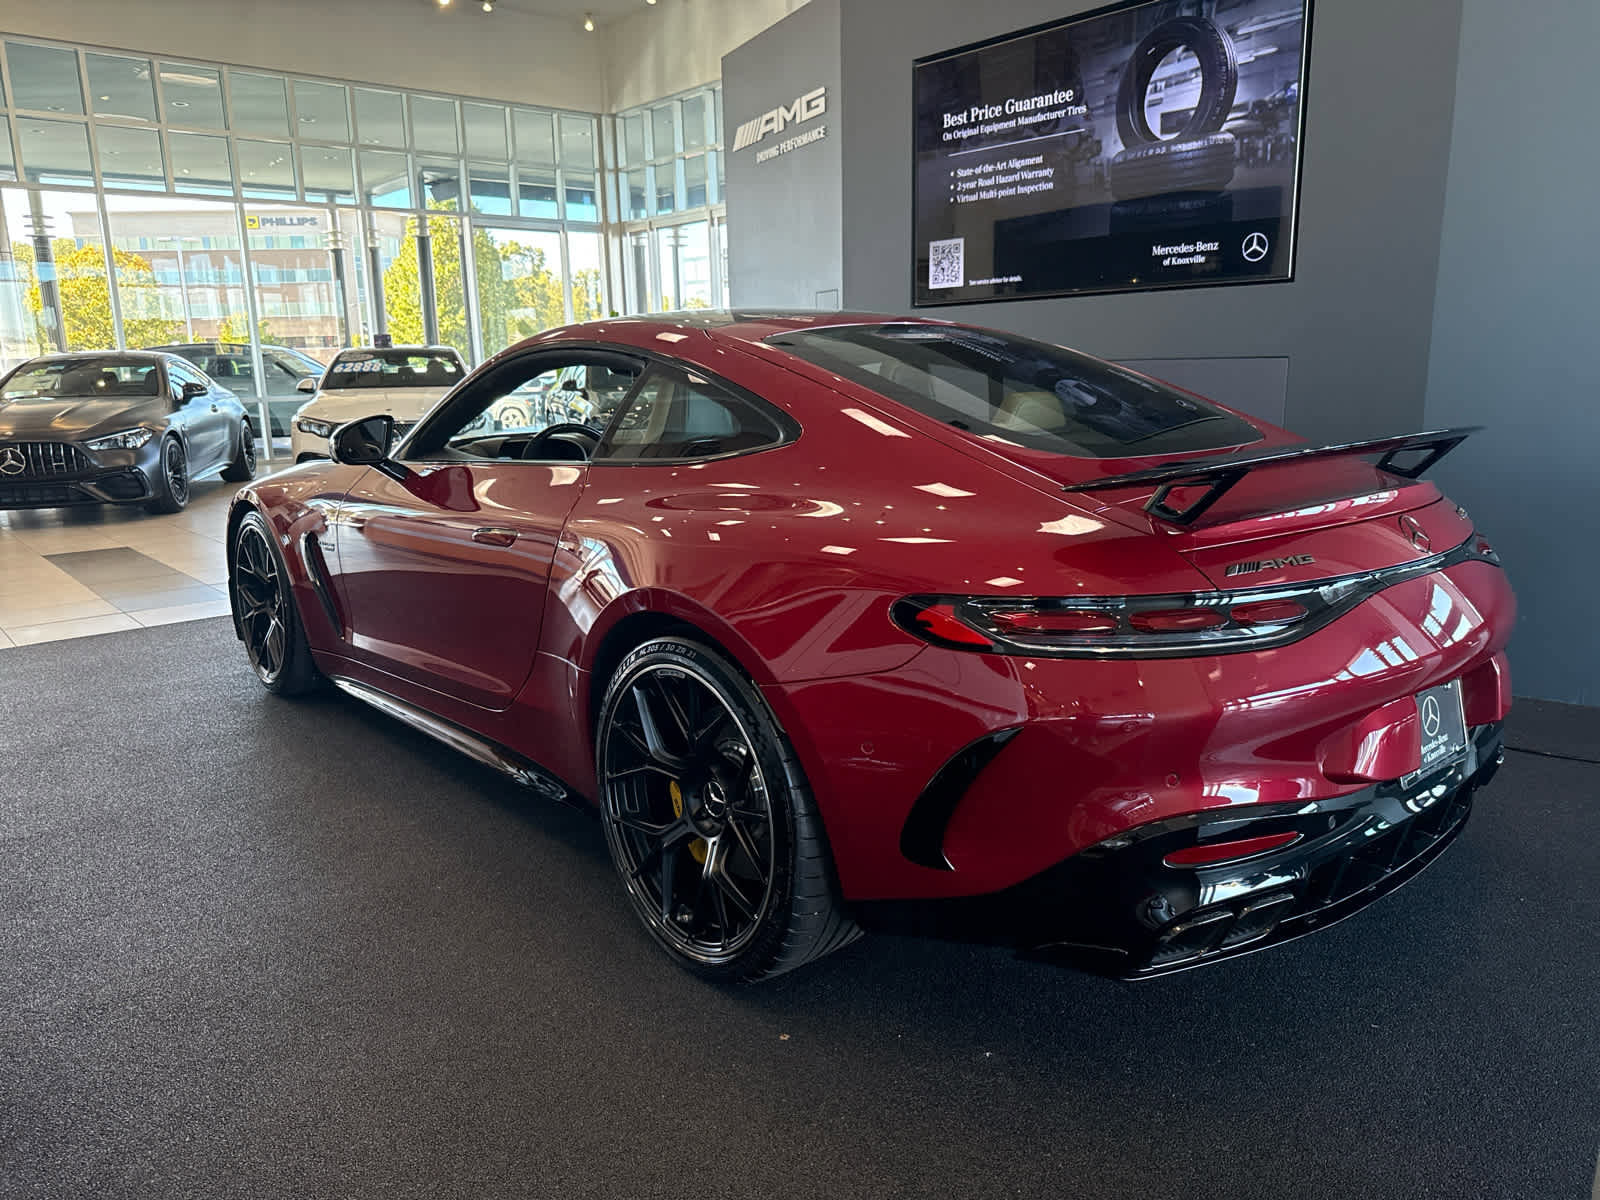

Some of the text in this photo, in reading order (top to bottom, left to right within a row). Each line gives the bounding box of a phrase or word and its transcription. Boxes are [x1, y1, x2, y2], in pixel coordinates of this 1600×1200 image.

[943, 89, 1074, 129] Best Price Guarantee
[942, 104, 1088, 142] On Original Equipment Manufacturer Tires
[956, 154, 1044, 178] State-of-the-Art Alignment
[956, 167, 1055, 192] 2-year Road Hazard Warranty
[956, 192, 979, 204] Virtual
[1017, 181, 1054, 195] Inspection
[261, 216, 317, 227] PHILLIPS
[1152, 241, 1220, 257] Mercedes-Benz
[1162, 254, 1206, 267] of Knoxville
